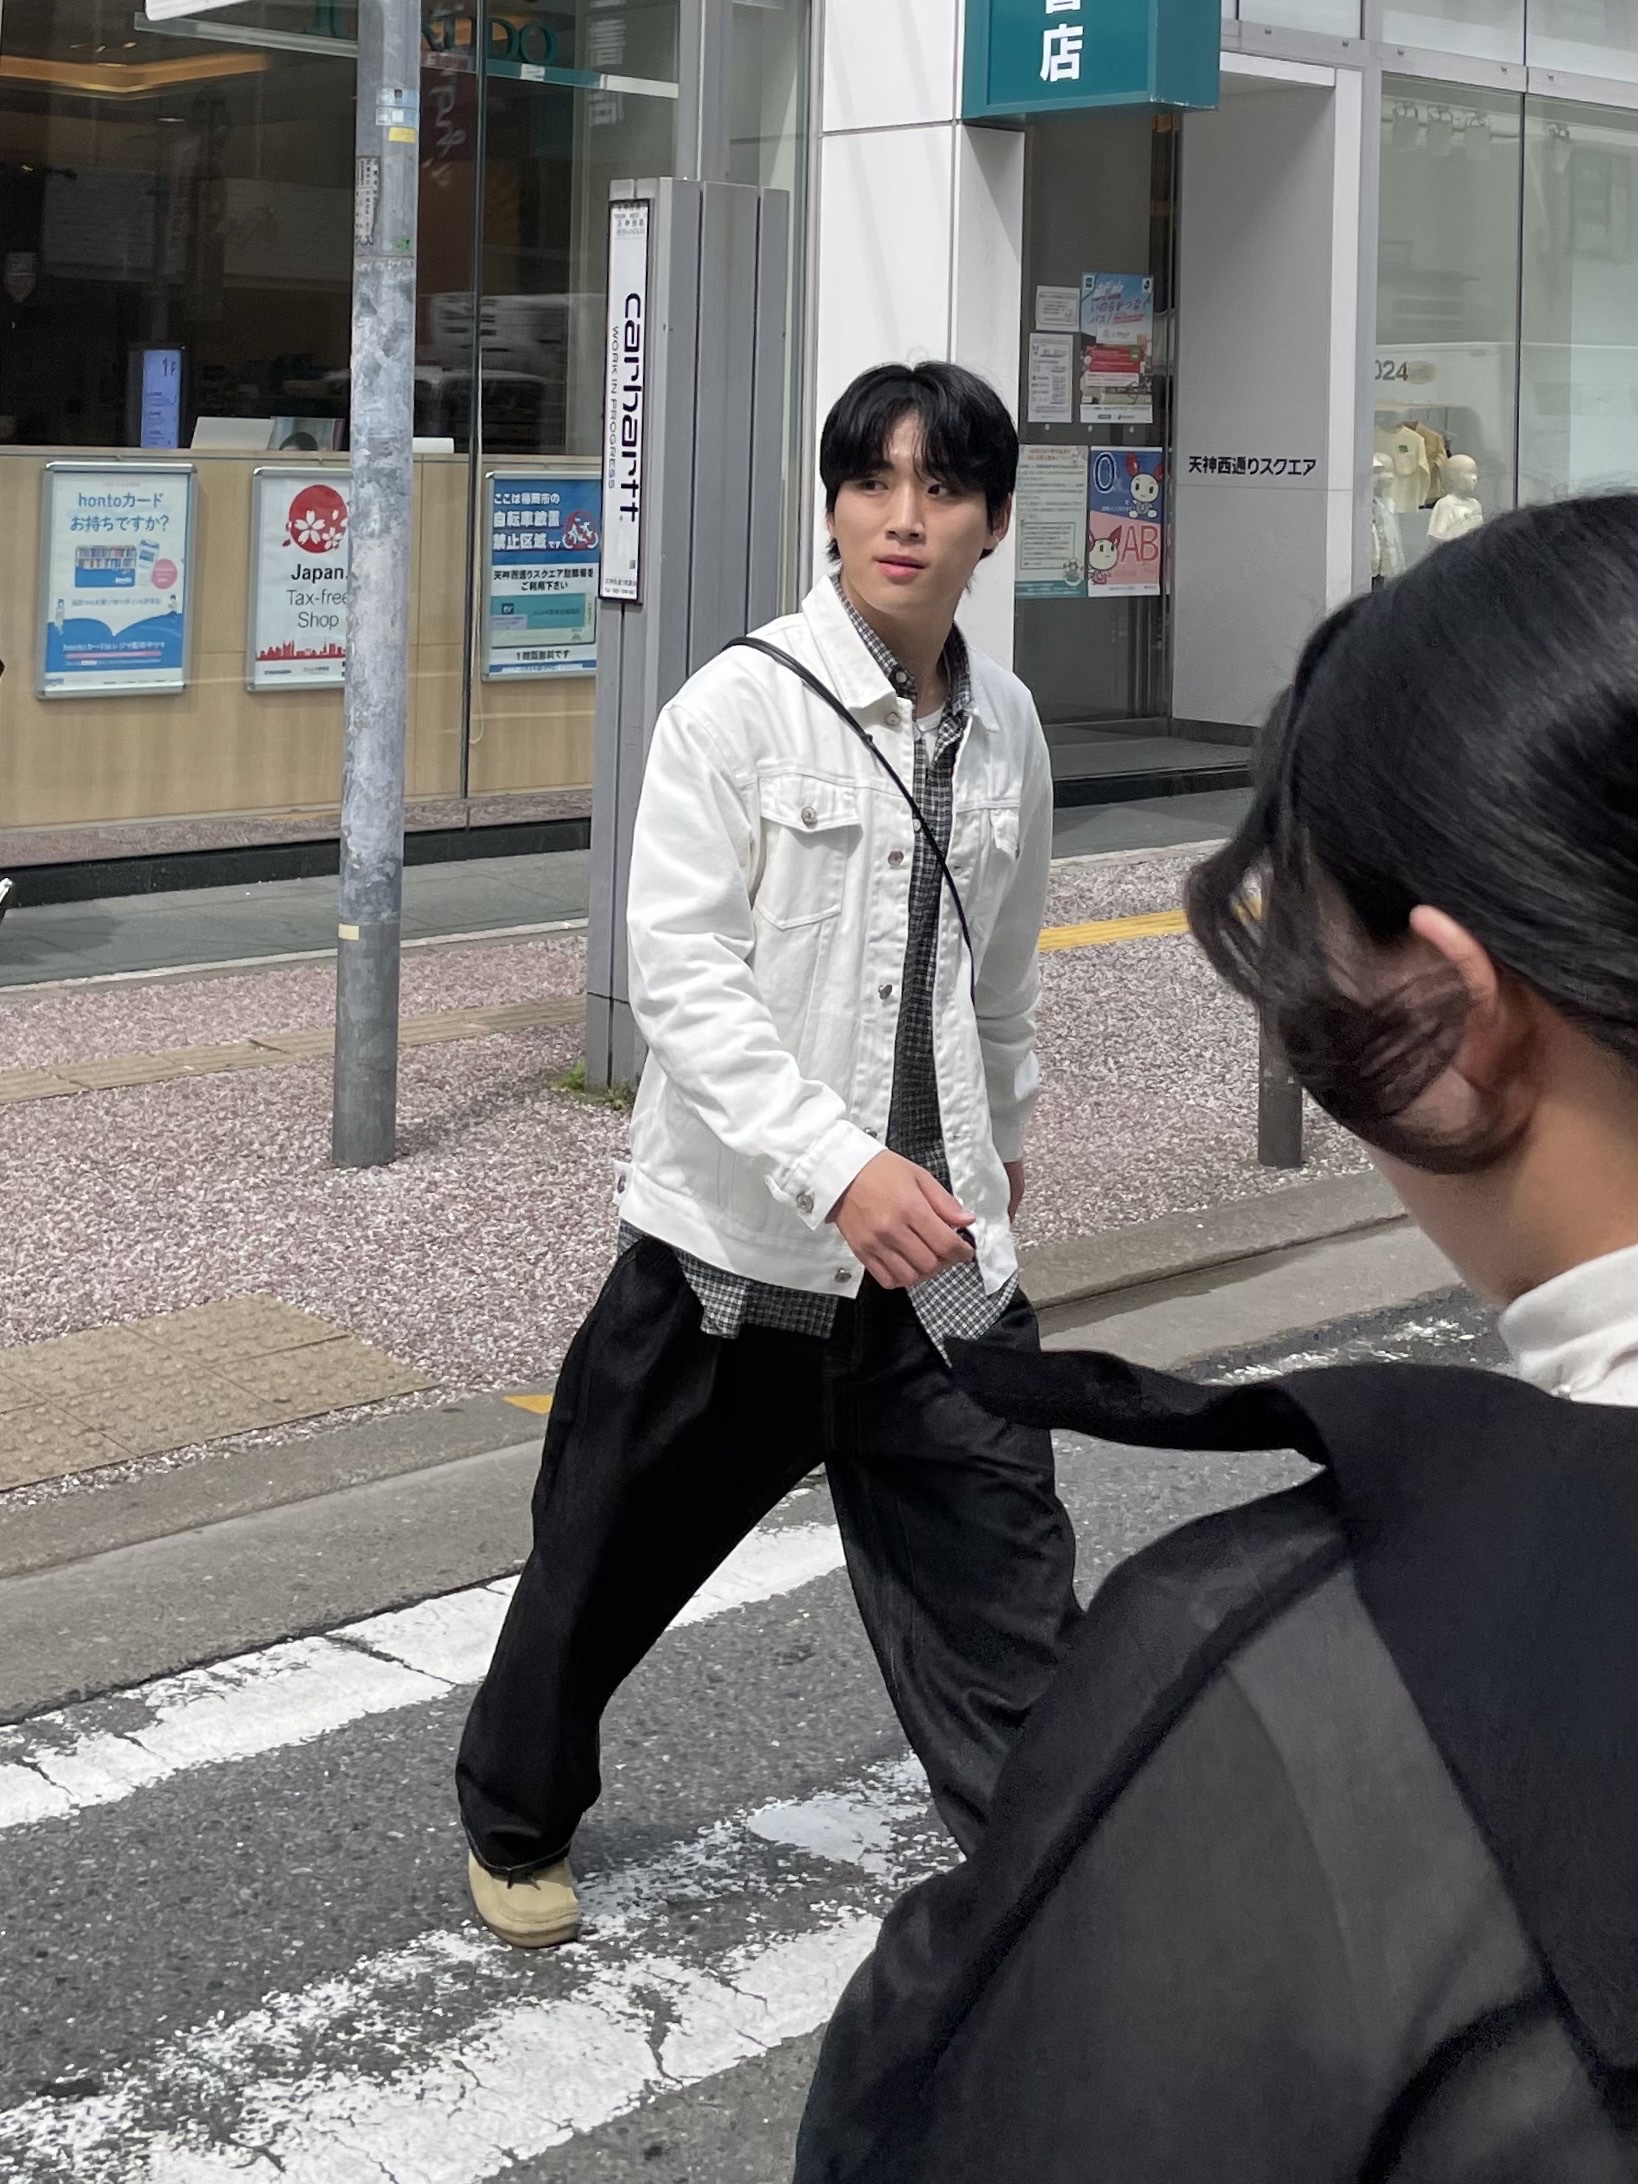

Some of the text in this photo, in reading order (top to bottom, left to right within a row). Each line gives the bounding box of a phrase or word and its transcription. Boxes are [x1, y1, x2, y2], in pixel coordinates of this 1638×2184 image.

[611, 326, 619, 376] WORK
[620, 292, 642, 522] carhartt
[608, 398, 618, 489] PROGRESS
[1188, 455, 1316, 476] 天神西通りスクエア
[297, 611, 339, 631] Shop
